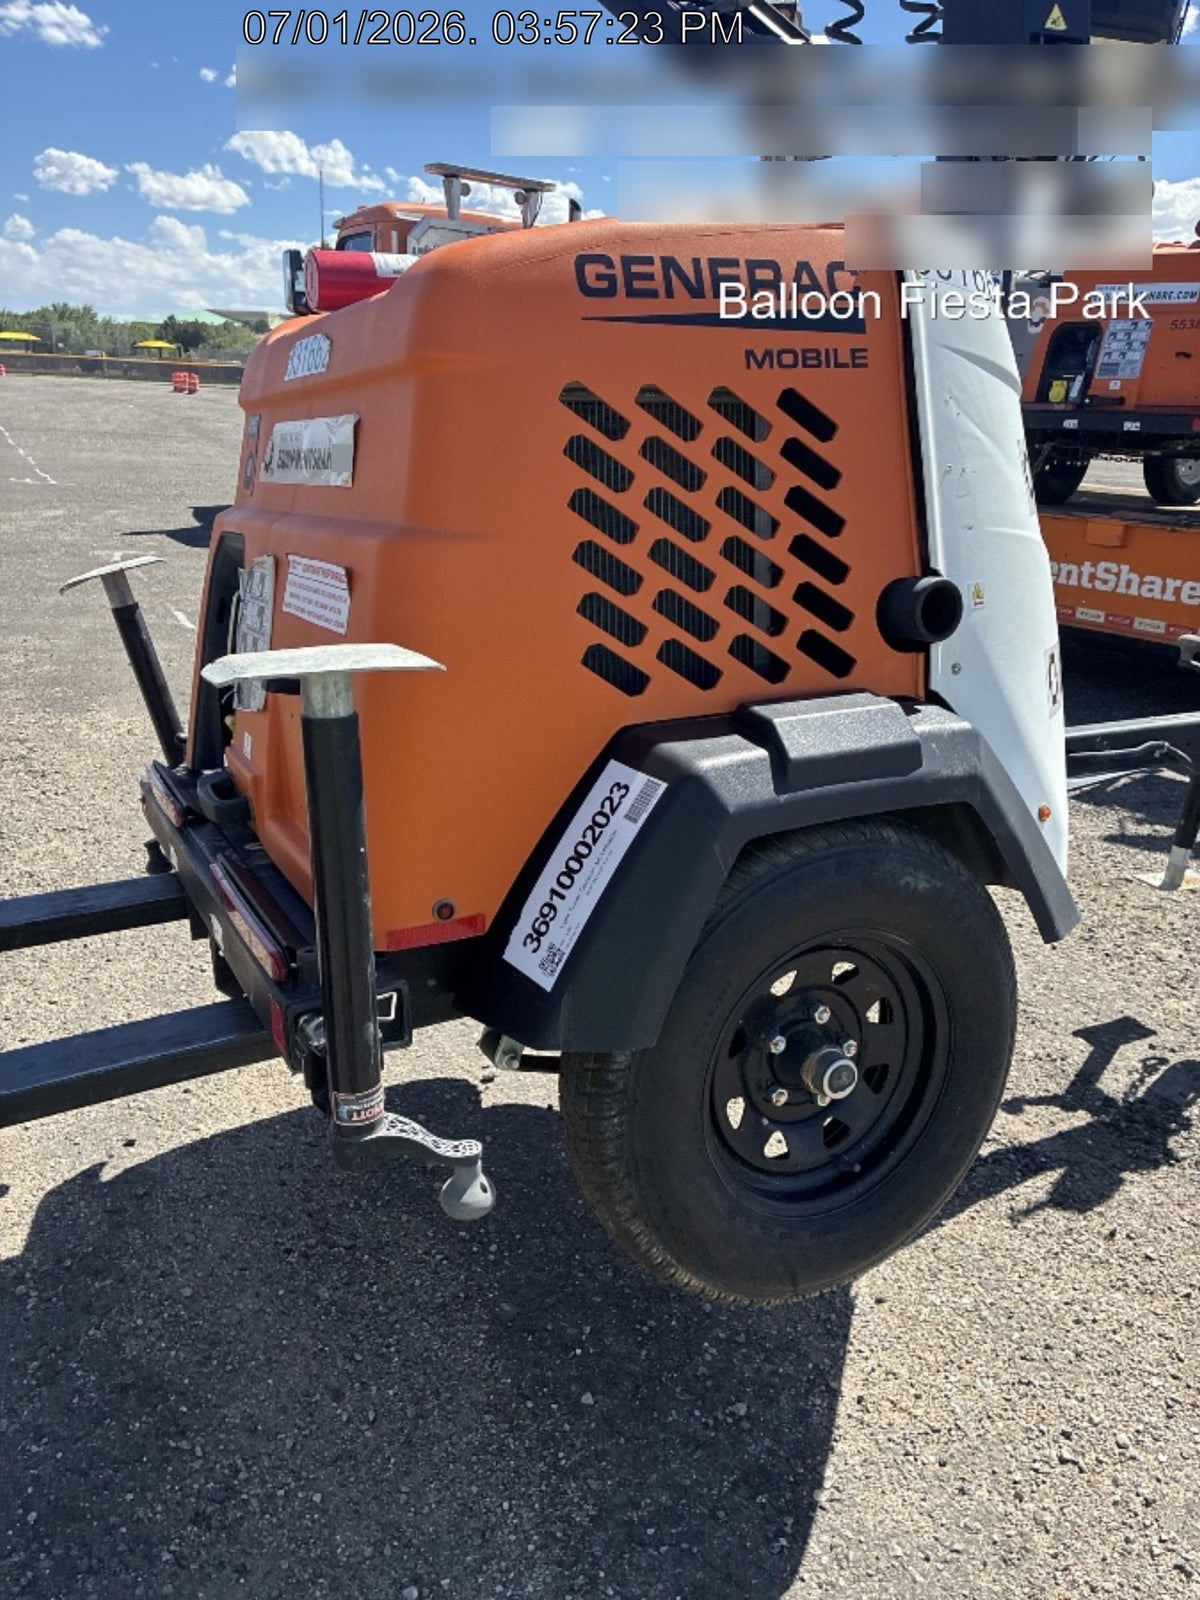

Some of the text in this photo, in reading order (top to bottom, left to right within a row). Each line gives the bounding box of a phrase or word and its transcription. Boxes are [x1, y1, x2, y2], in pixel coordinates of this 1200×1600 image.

[574, 253, 862, 301] GENERAC
[744, 348, 869, 370] MOBILE
[522, 781, 631, 954] 36910002023
